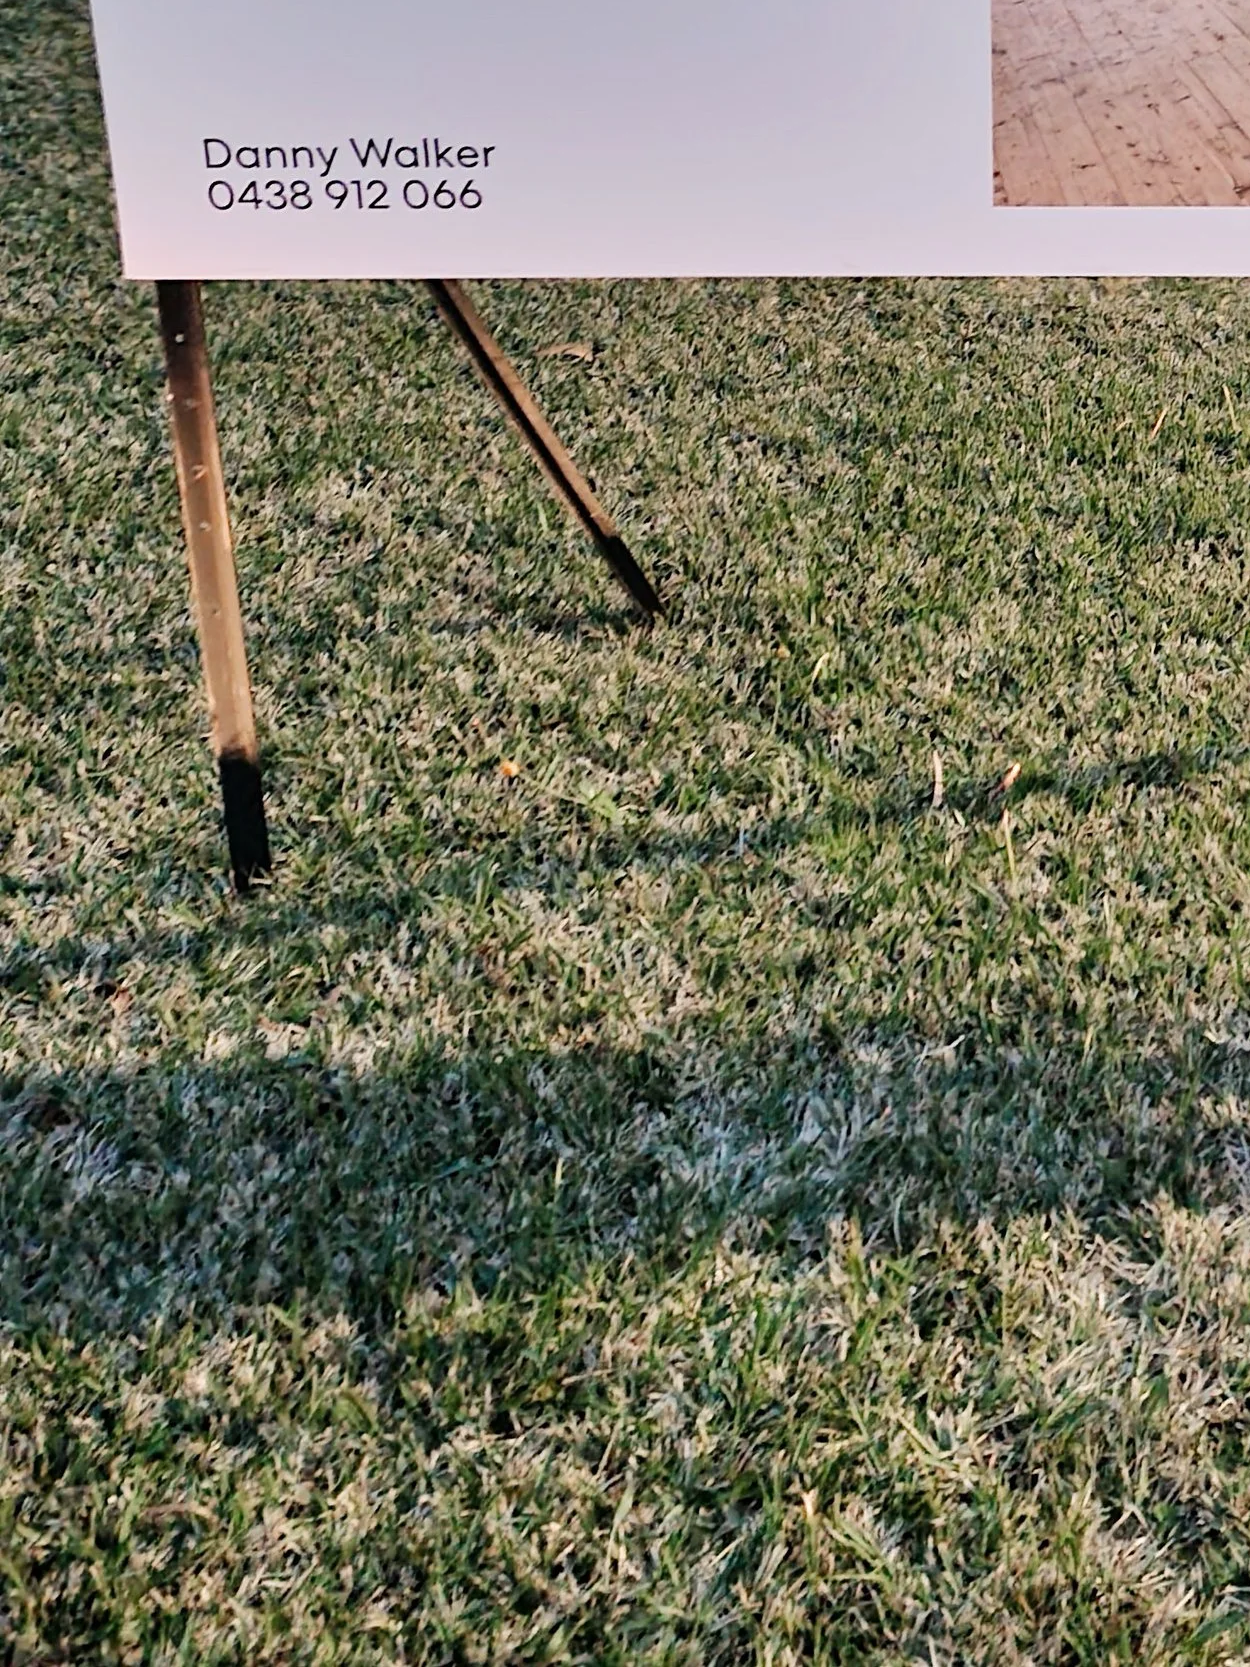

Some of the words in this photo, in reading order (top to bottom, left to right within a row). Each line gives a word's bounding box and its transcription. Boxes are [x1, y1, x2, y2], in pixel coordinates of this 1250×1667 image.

[203, 138, 338, 177] Danny
[349, 137, 496, 168] Walker
[208, 179, 313, 211] 0438
[325, 179, 390, 210] 912
[403, 179, 482, 210] 066
